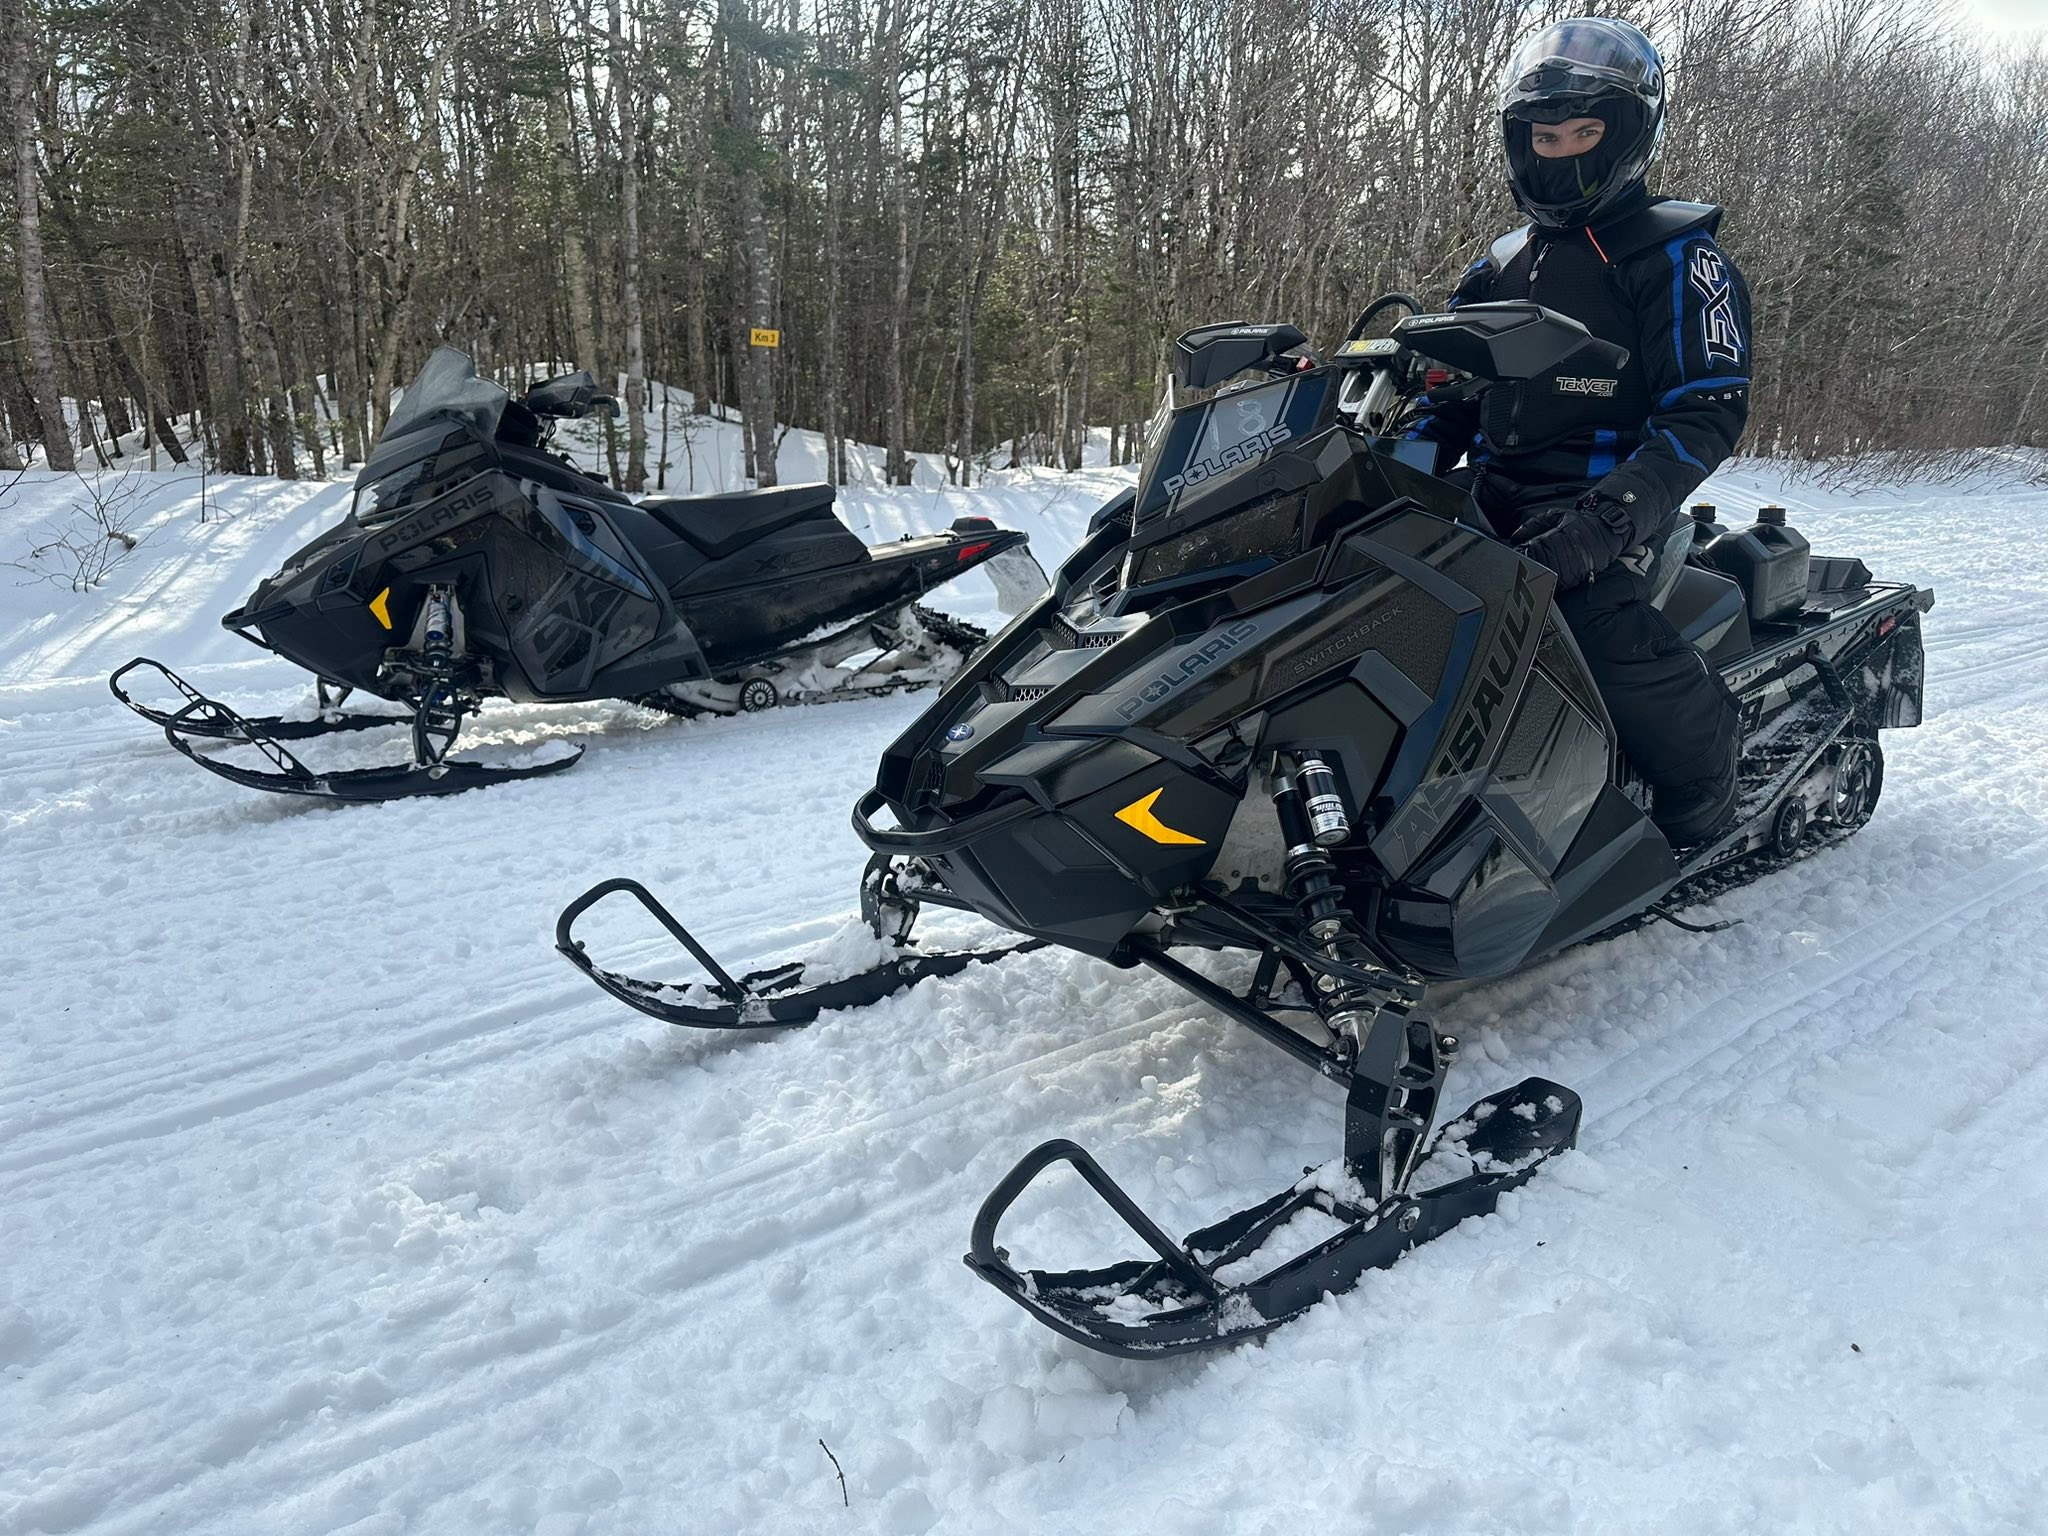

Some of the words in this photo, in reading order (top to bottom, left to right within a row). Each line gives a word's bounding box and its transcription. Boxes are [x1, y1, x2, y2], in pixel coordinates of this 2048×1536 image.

[754, 332, 769, 342] Km
[770, 333, 776, 343] 3
[1418, 315, 1457, 325] POLARIS
[1690, 247, 1743, 363] FXR
[1162, 422, 1292, 496] POLARIS
[379, 486, 494, 552] POLARIS
[1112, 620, 1260, 722] POLARIS
[1293, 606, 1404, 674] SWITCHBACK
[1393, 559, 1537, 867] ASSAULT
